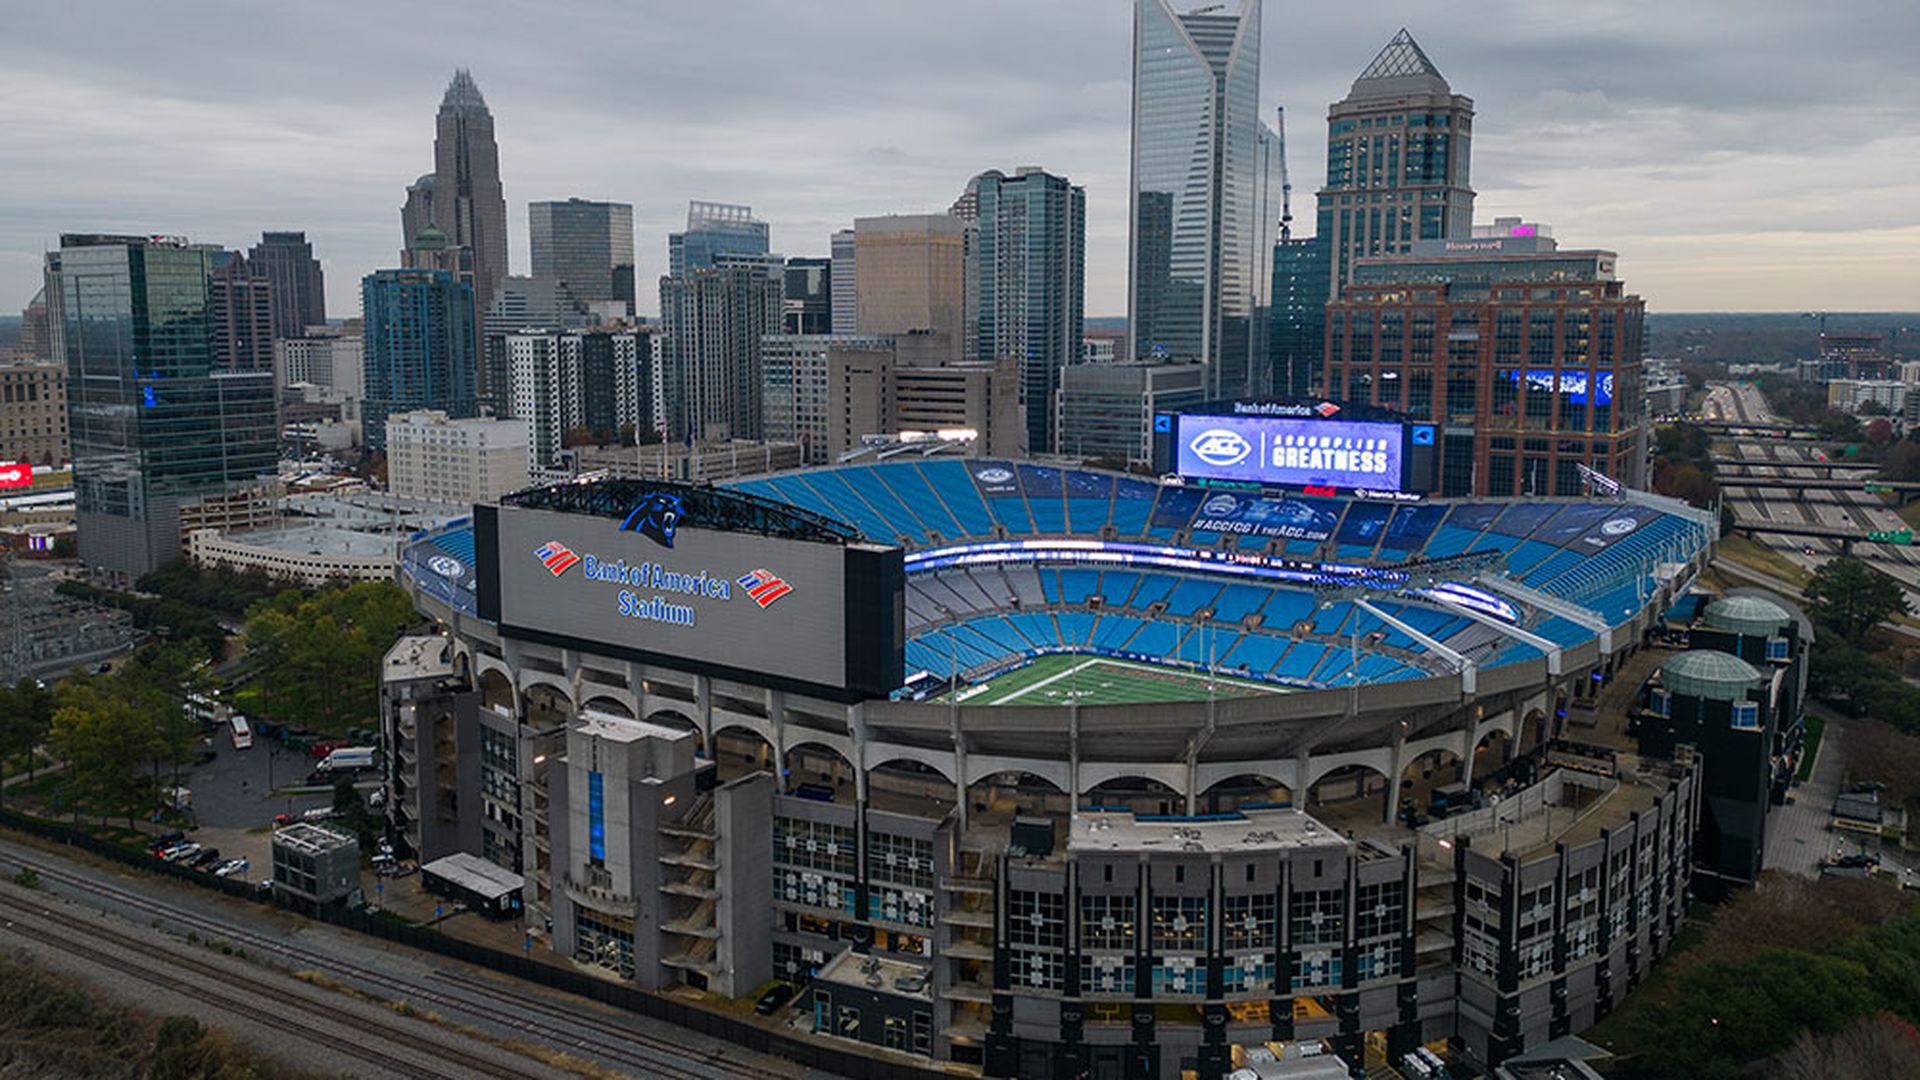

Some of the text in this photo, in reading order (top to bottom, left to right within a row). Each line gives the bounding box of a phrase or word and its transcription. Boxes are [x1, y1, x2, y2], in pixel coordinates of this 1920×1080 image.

[1272, 447, 1387, 473] GREATNESS
[584, 554, 731, 600] Bank of America
[617, 588, 695, 626] Stadium
